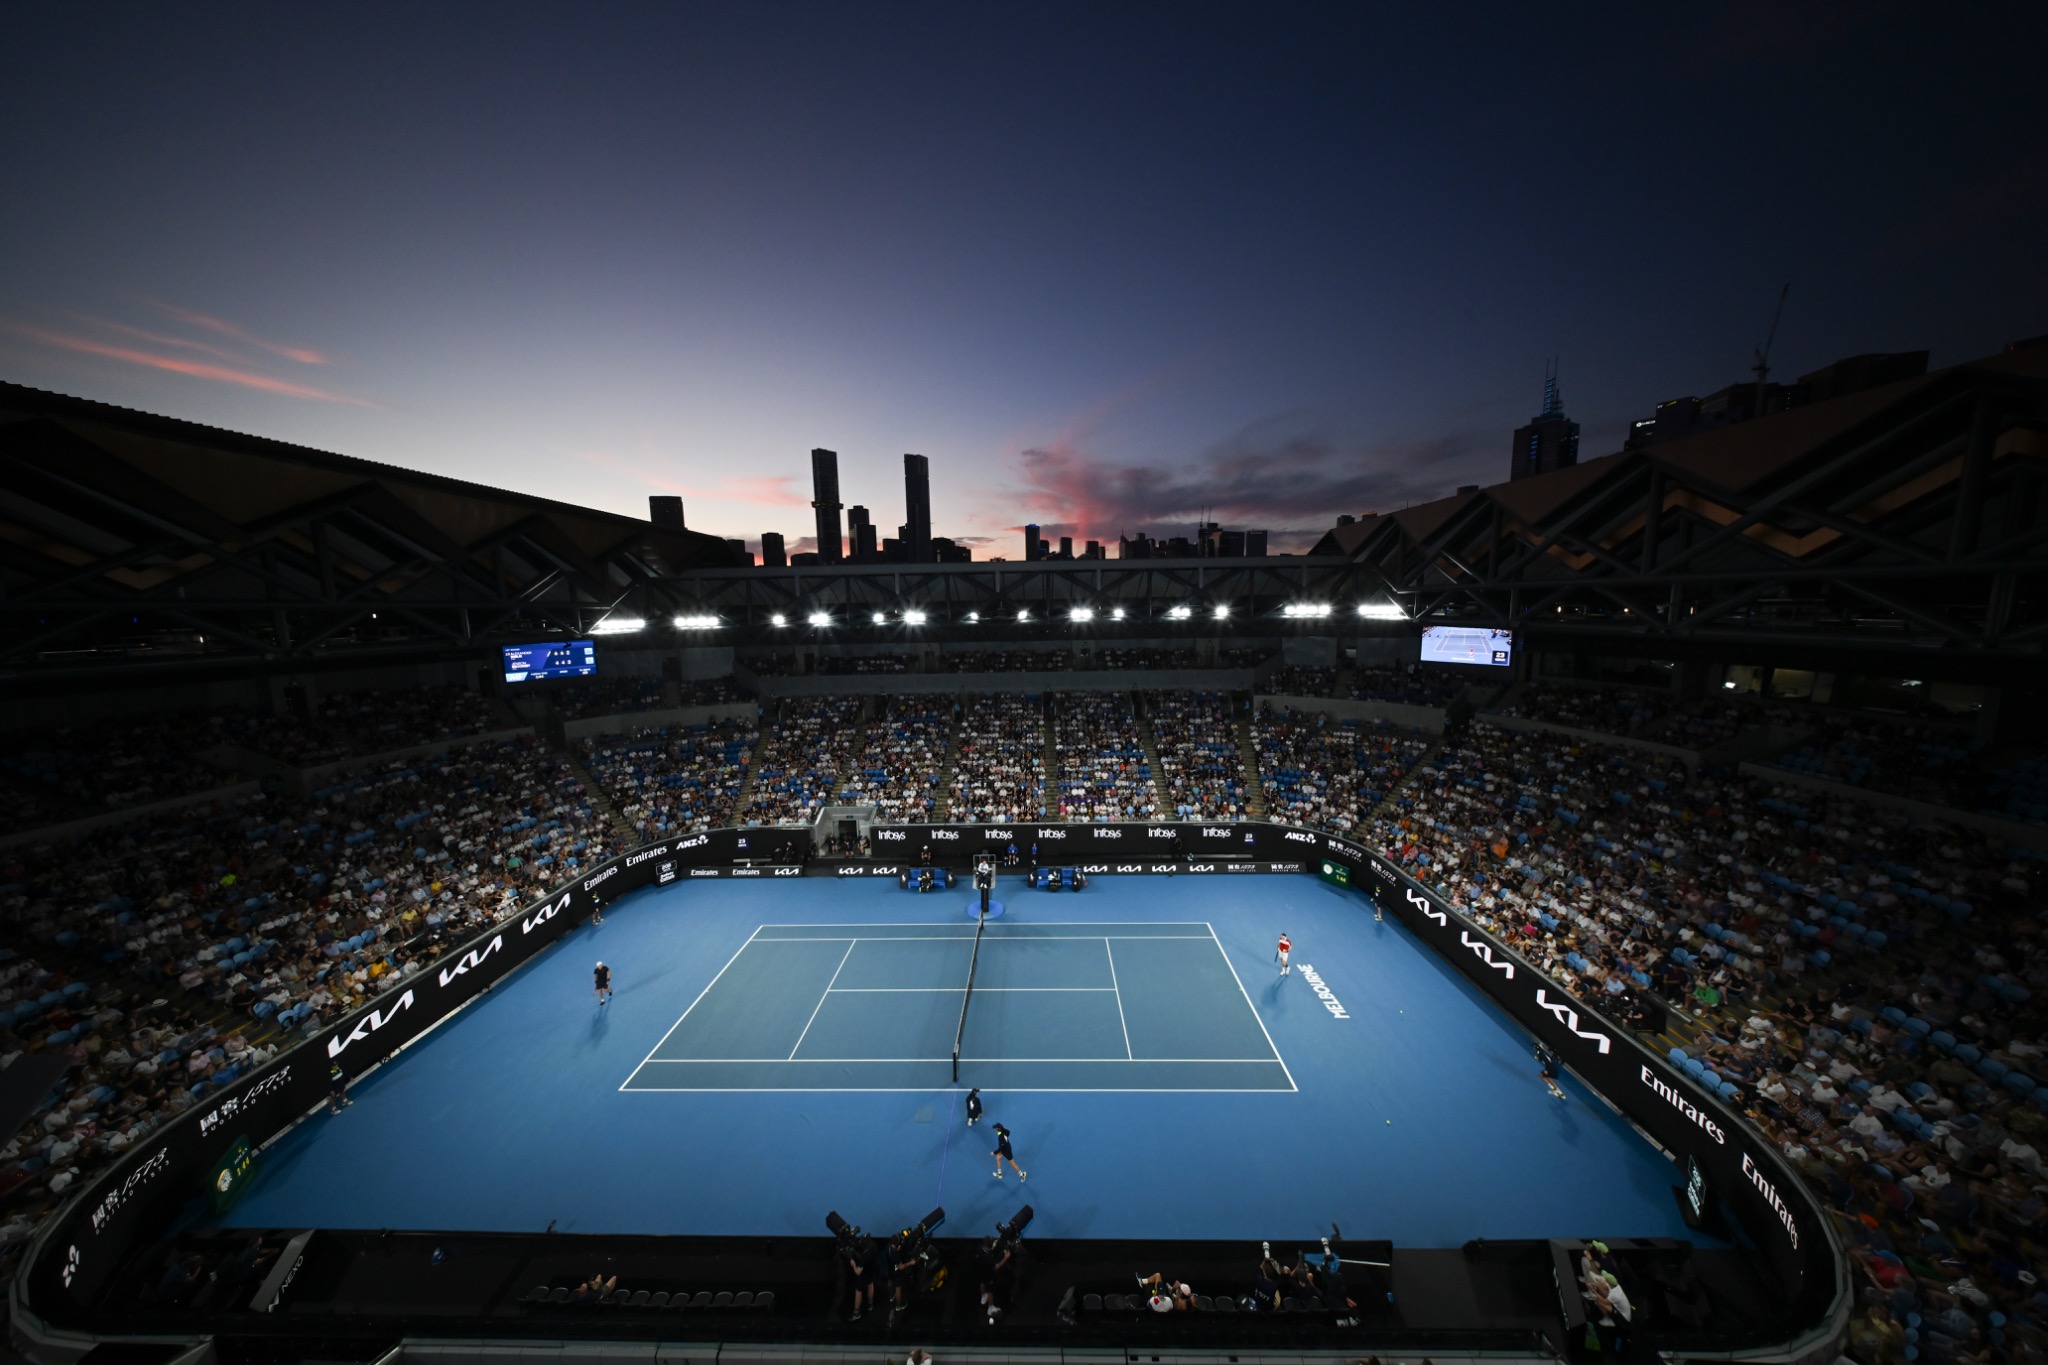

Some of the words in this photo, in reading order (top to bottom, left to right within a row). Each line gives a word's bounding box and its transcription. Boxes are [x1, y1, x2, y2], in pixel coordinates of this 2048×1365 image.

[878, 829, 906, 841] Infosys
[931, 829, 959, 841] Infosys
[985, 829, 1013, 841] Infosys
[1039, 828, 1066, 840] Infosys
[1093, 828, 1121, 839] Infosys
[1148, 827, 1176, 839] Infosys
[1202, 827, 1231, 838] Infosys
[1284, 831, 1306, 842] ANZ
[676, 838, 698, 850] ANZ
[626, 845, 667, 868] Emirates
[584, 865, 618, 891] Emirates
[1296, 964, 1351, 1019] MELBOURNE
[242, 1065, 291, 1104] 1573
[1641, 1064, 1725, 1146] Emirates
[122, 1147, 168, 1196] 1573
[1741, 1152, 1798, 1250] Emirates
